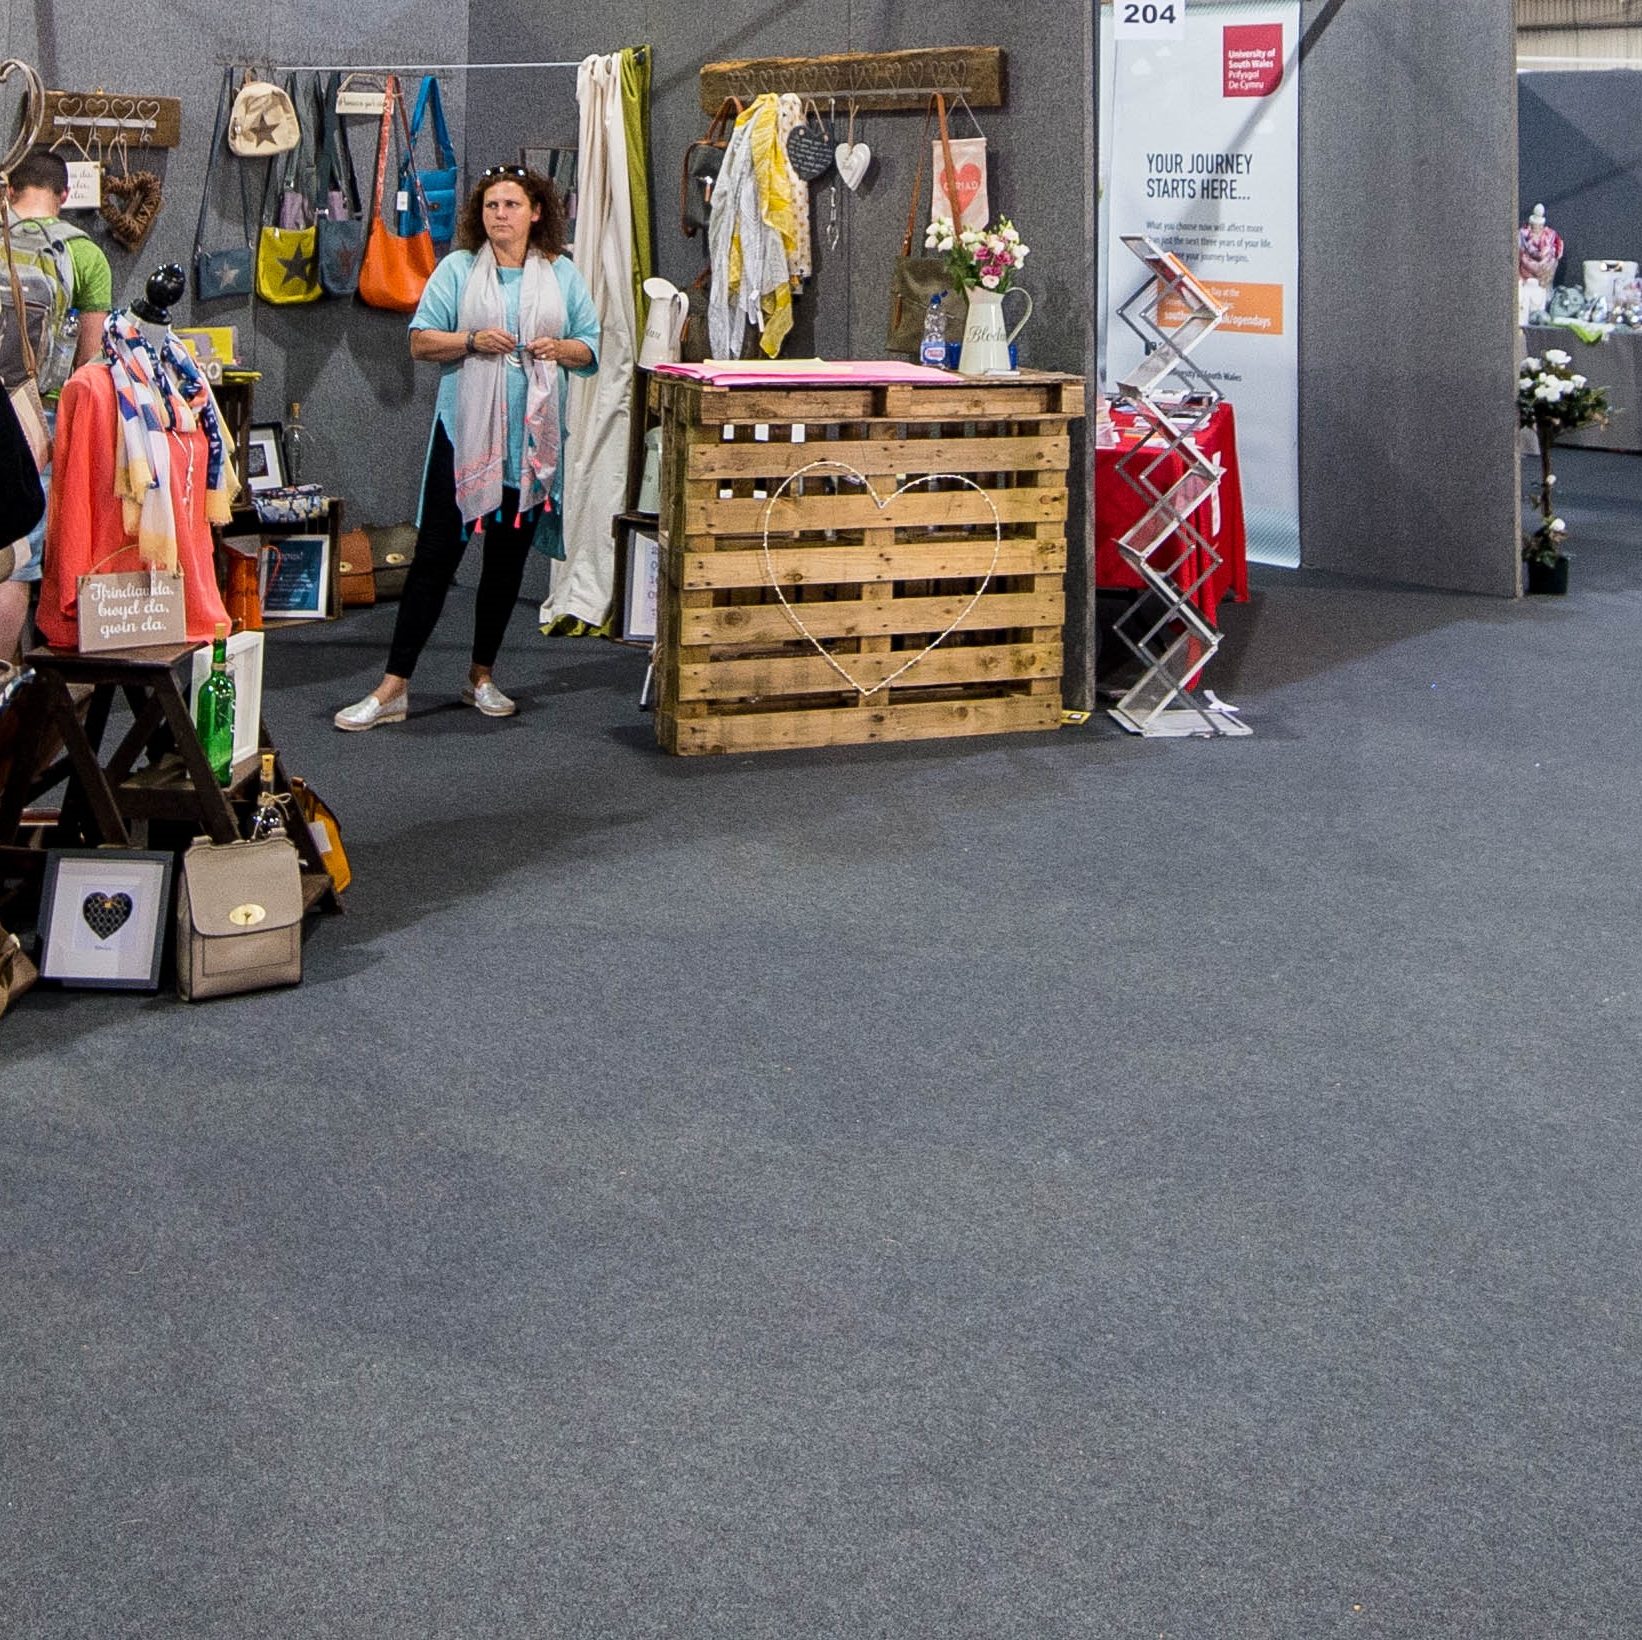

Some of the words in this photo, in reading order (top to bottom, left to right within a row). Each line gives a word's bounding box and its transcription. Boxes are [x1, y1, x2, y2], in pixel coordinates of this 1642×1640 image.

[1124, 3, 1176, 24] 204
[1228, 49, 1266, 59] University
[1267, 48, 1276, 57] of
[1228, 59, 1250, 69] South
[1251, 59, 1274, 68] Wales
[1228, 69, 1260, 80] Prifysgol
[1228, 80, 1238, 89] De
[1239, 80, 1264, 90] Cymru
[1146, 153, 1183, 174] YOUR
[1187, 153, 1253, 175] JOURNEY
[1146, 178, 1197, 199] STARTS
[1200, 179, 1251, 200] HERE...
[1177, 222, 1197, 231] choose
[98, 600, 140, 620] bwyd
[100, 619, 137, 639] gwin
